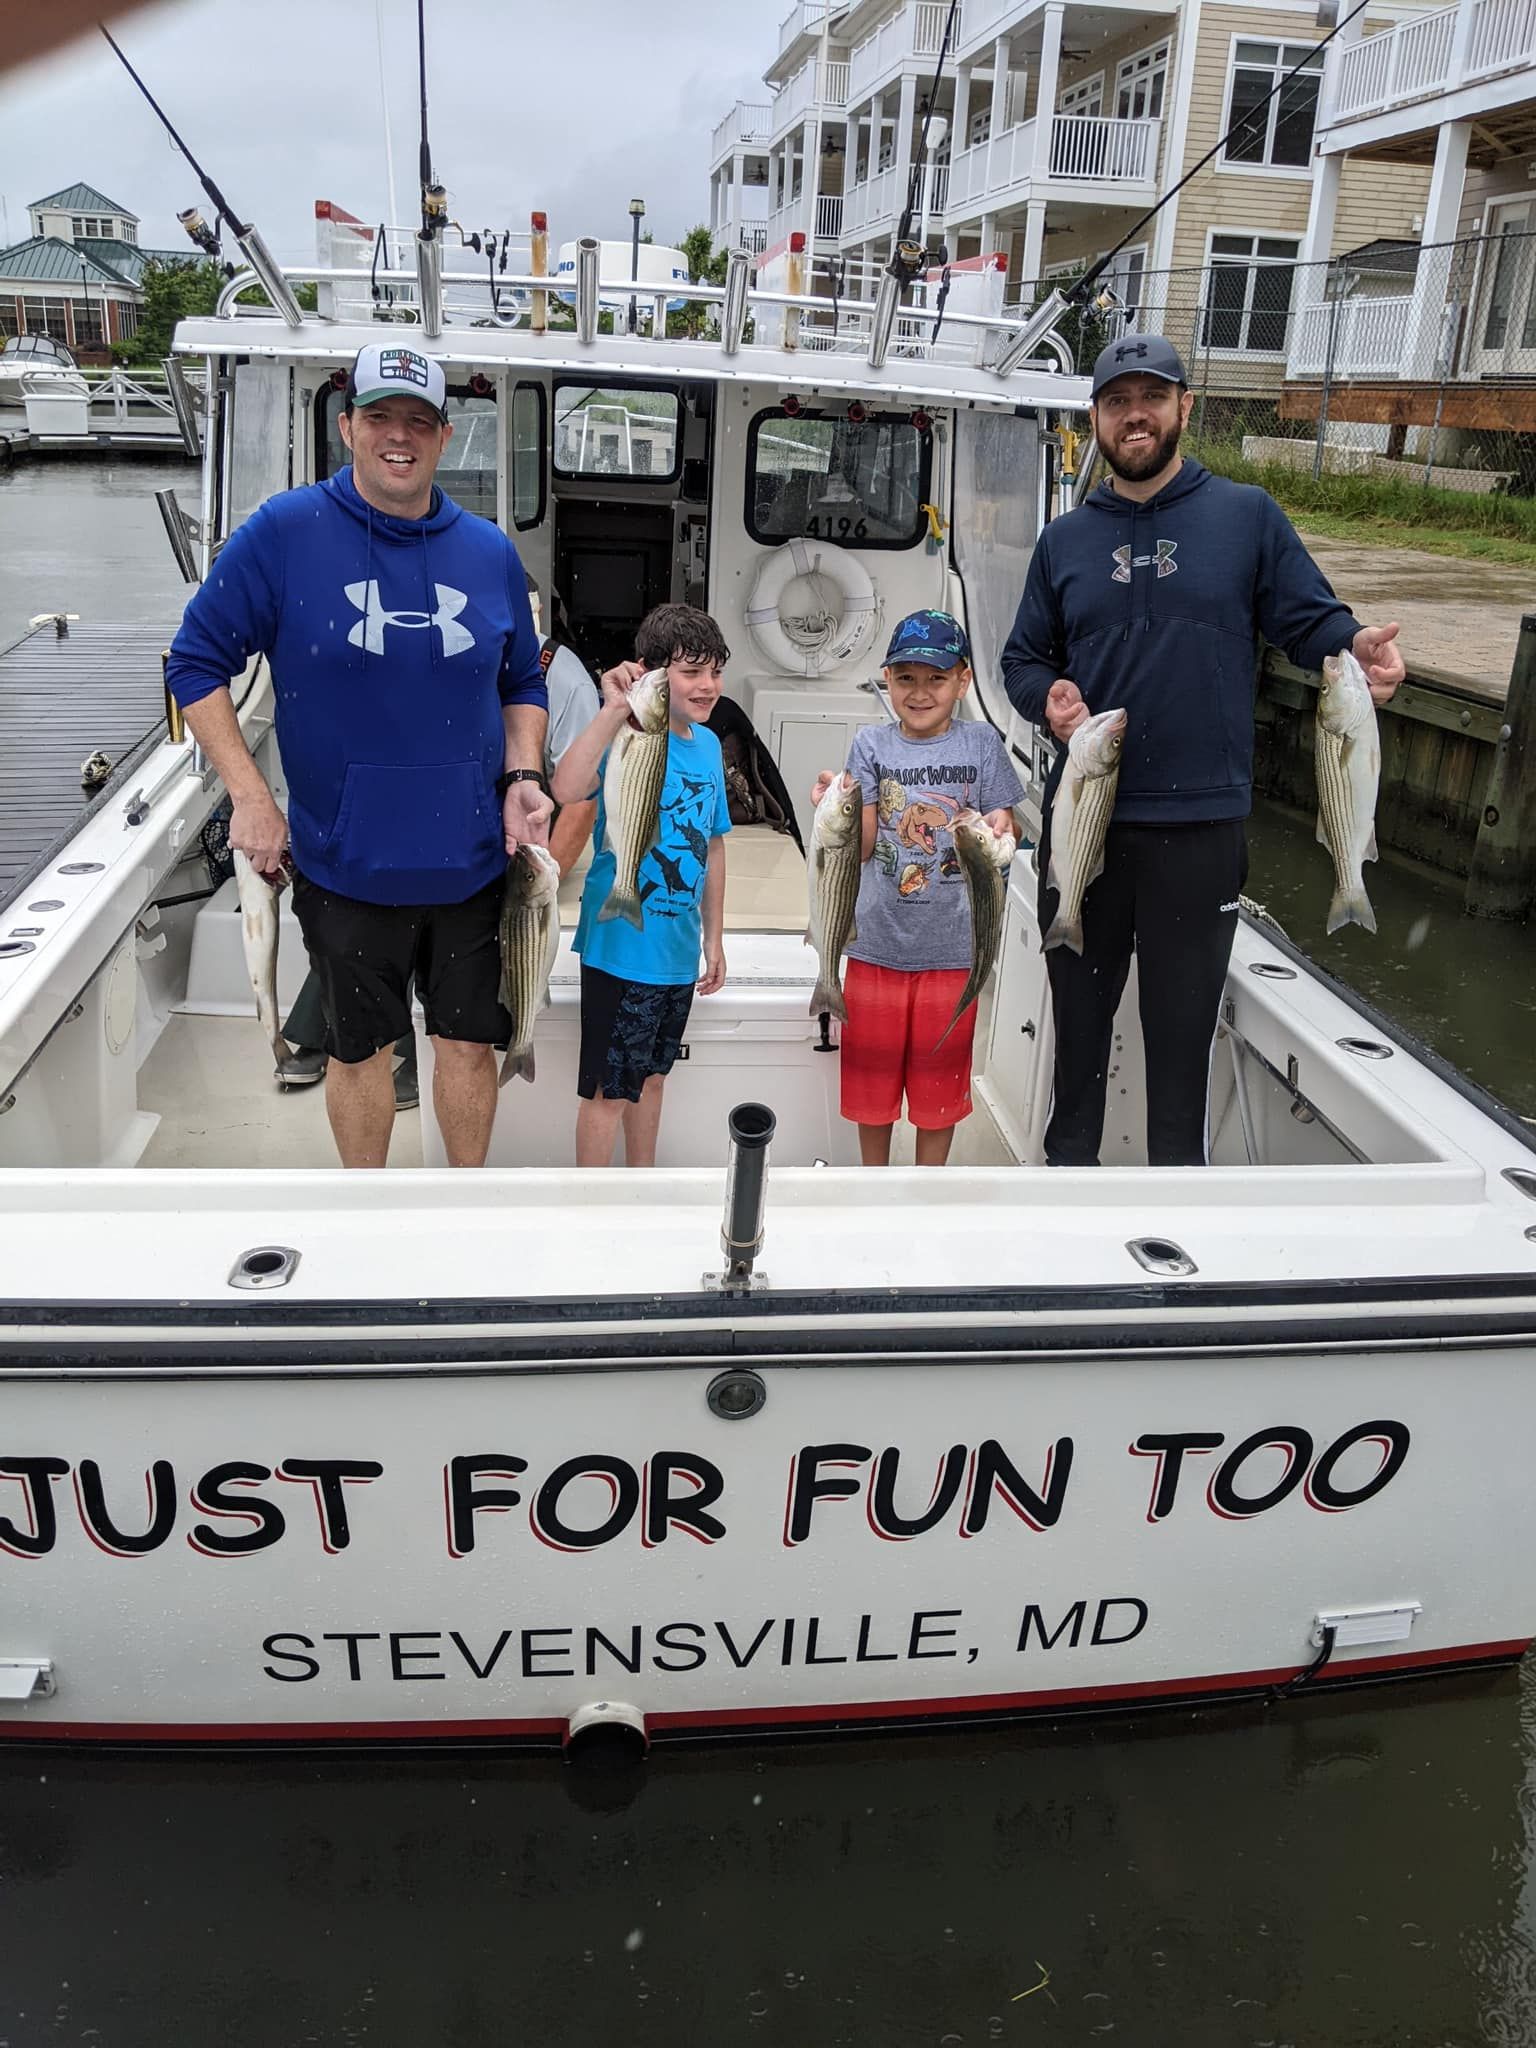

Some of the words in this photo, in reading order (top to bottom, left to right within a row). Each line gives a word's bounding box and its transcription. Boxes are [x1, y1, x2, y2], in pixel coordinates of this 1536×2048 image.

[807, 516, 867, 537] 4196
[926, 765, 978, 785] WORLD
[0, 1456, 384, 1559] JUST
[443, 1451, 727, 1559] FOR
[783, 1436, 1074, 1547] FUN
[1128, 1420, 1411, 1522] TOO
[262, 1609, 980, 1682] STEVENSVILLE,
[1017, 1597, 1150, 1651] MD
